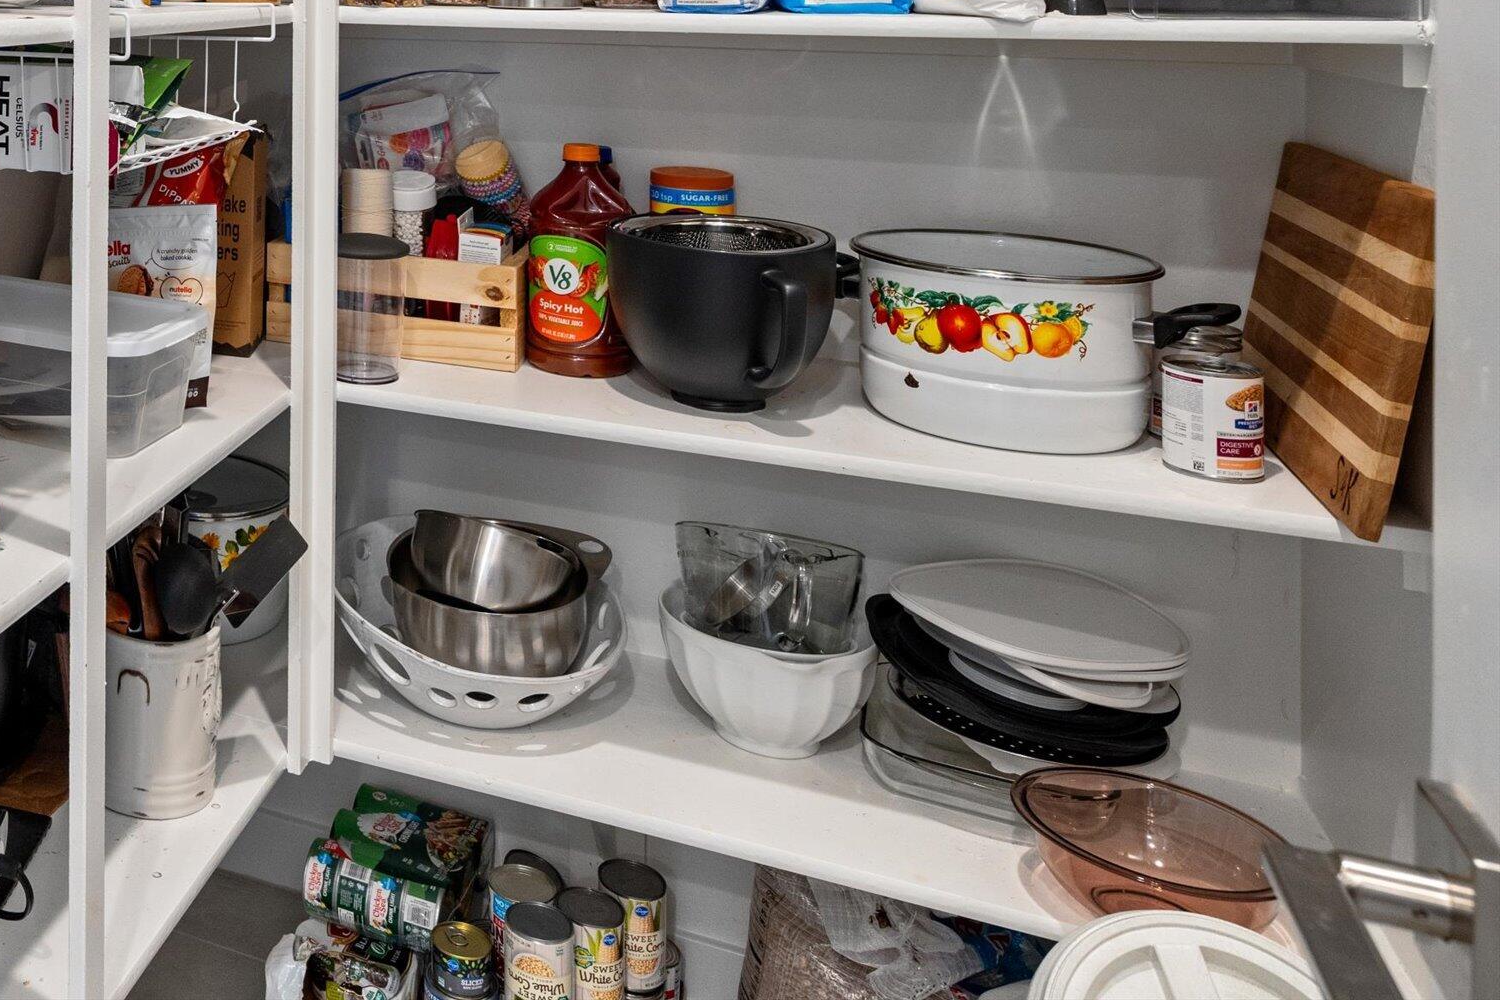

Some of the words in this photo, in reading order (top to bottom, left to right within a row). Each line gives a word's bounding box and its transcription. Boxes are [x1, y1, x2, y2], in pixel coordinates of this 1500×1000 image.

[15, 96, 24, 139] CELSIUS
[169, 160, 201, 177] YUMMY
[661, 193, 673, 203] tsp
[160, 254, 175, 262] baked
[549, 263, 573, 290] V8
[169, 285, 193, 294] nutella
[539, 297, 562, 313] Spicy
[564, 303, 584, 315] Hot
[1220, 440, 1254, 449] DIGESTIVE
[1220, 447, 1240, 455] CARE
[307, 861, 319, 892] Chicken
[371, 888, 382, 918] Chicken
[646, 940, 664, 954] Corn
[460, 978, 484, 987] SLICED
[508, 967, 531, 991] Corn
[579, 970, 612, 984] White
[534, 981, 565, 996] White
